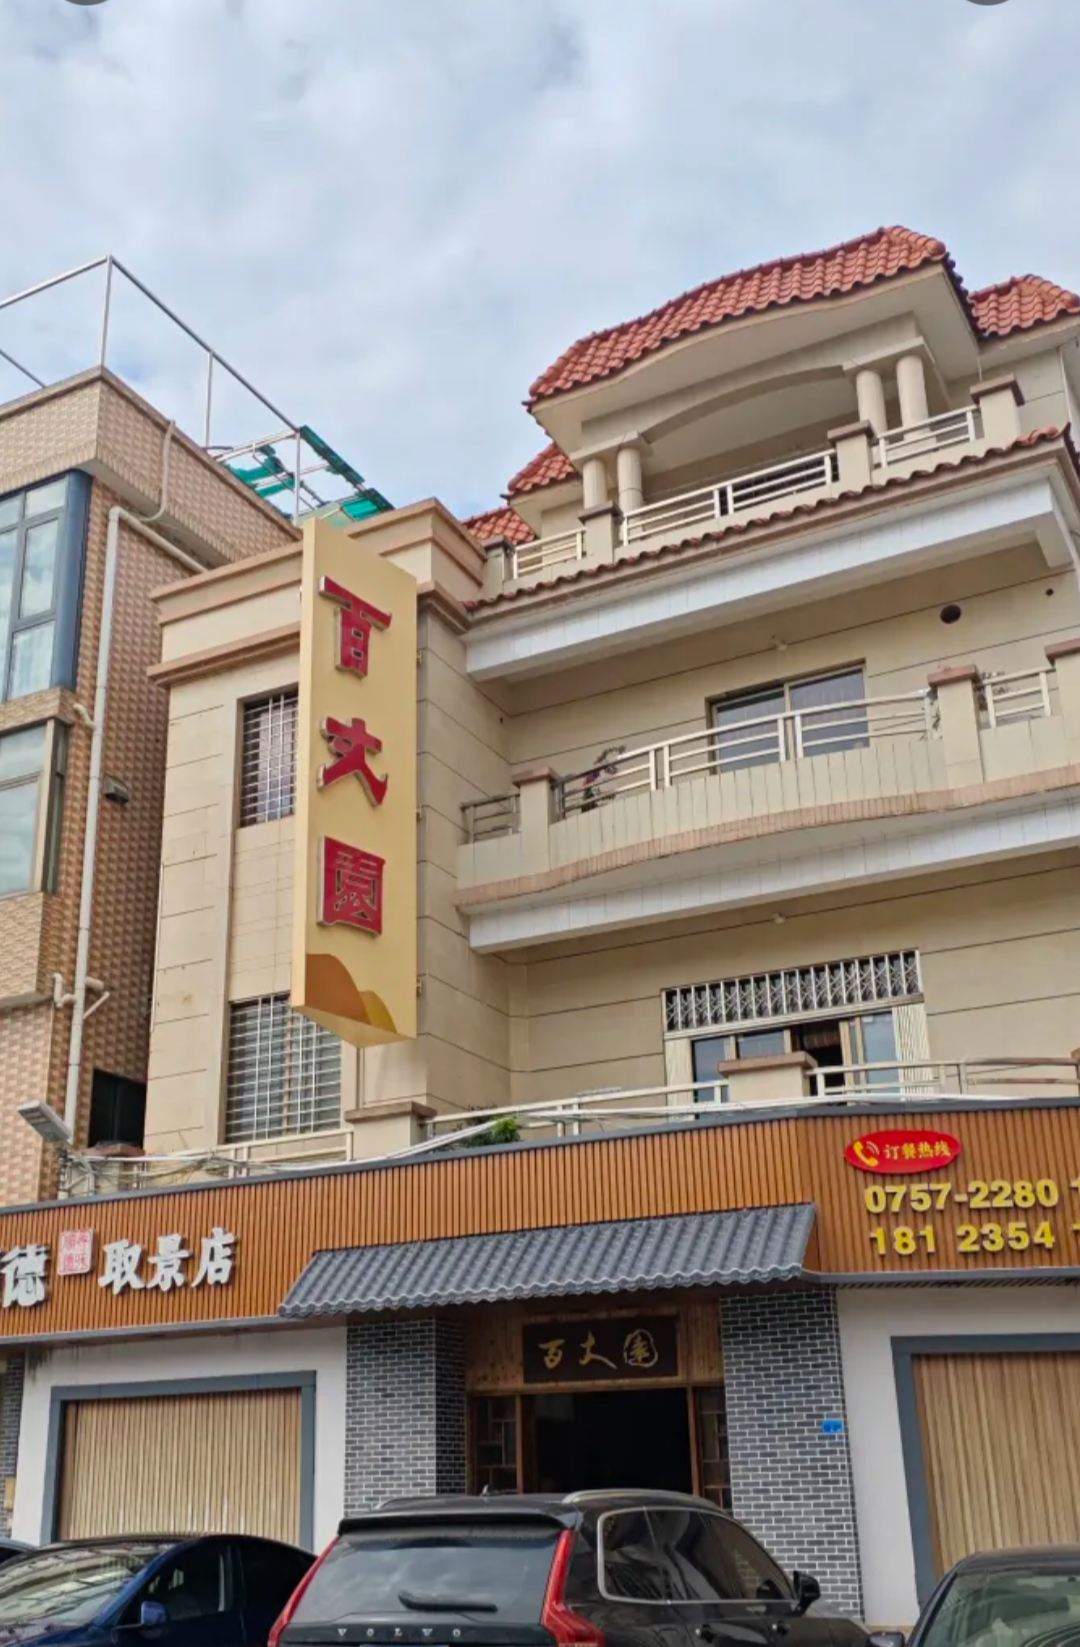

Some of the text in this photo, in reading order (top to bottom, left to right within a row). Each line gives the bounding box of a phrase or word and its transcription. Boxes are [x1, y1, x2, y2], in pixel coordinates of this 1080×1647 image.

[883, 1140, 951, 1160] 订餐热线
[864, 1178, 1059, 1214] 0757-2280
[870, 1225, 936, 1255] 181
[956, 1221, 1055, 1253] 2354
[97, 1226, 235, 1295] 取景店
[337, 1627, 462, 1638] VOLVO
